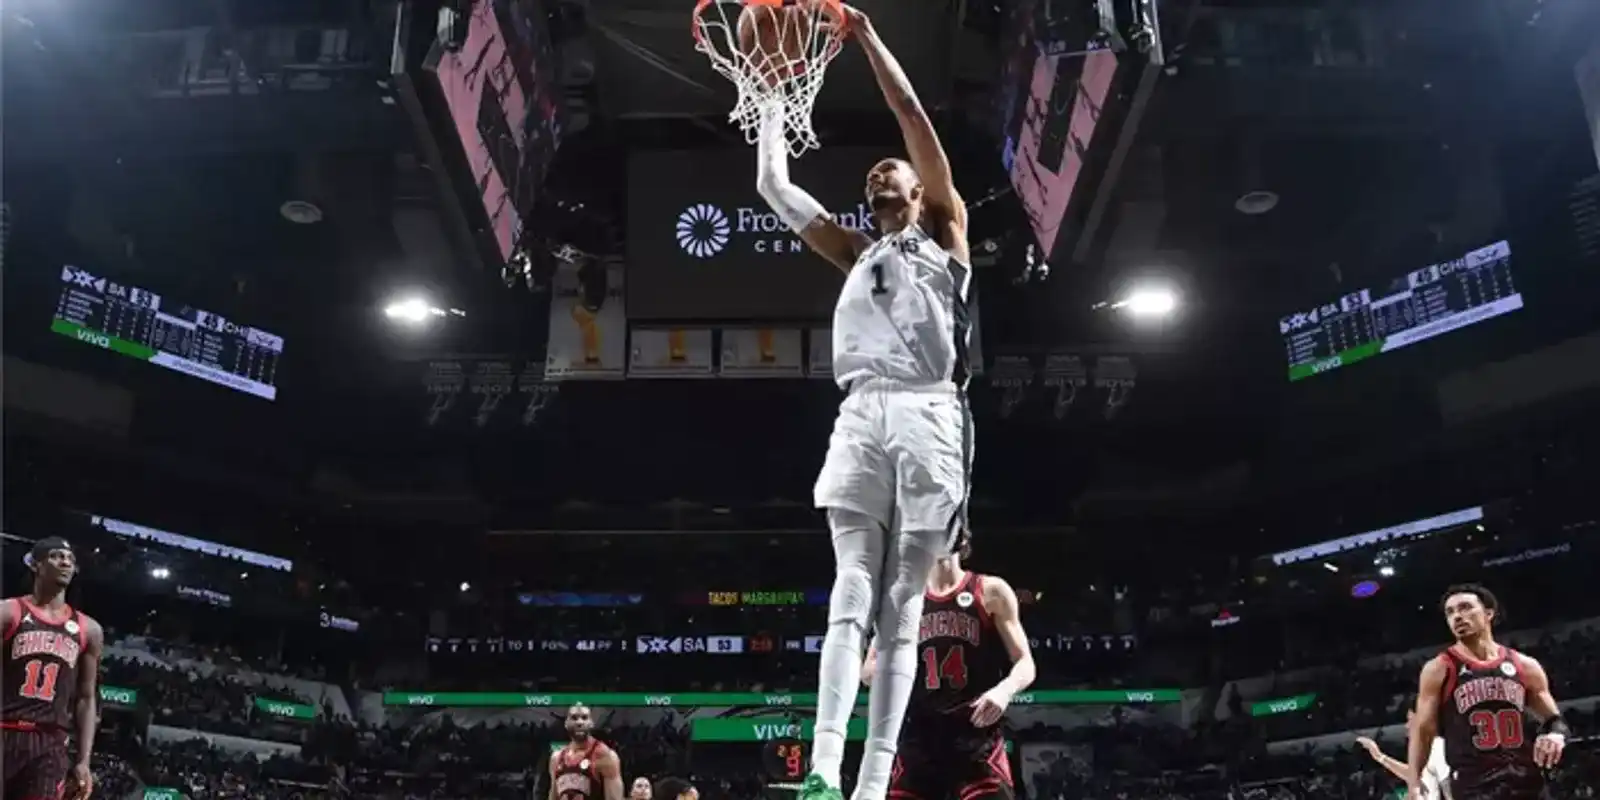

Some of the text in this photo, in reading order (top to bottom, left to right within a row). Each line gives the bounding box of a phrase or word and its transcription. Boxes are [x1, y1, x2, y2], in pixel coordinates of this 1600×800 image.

[736, 203, 875, 232] Fros ank
[754, 239, 802, 252] CEN
[108, 281, 126, 297] SA
[871, 263, 889, 296] 1
[1320, 303, 1338, 317] SA
[684, 638, 705, 651] SA
[919, 610, 980, 646] HICAGO
[12, 630, 79, 668] CHICAGO
[19, 660, 59, 701] 11
[922, 644, 968, 690] 14
[1454, 676, 1525, 714] CHICAGO
[1469, 709, 1524, 751] 30
